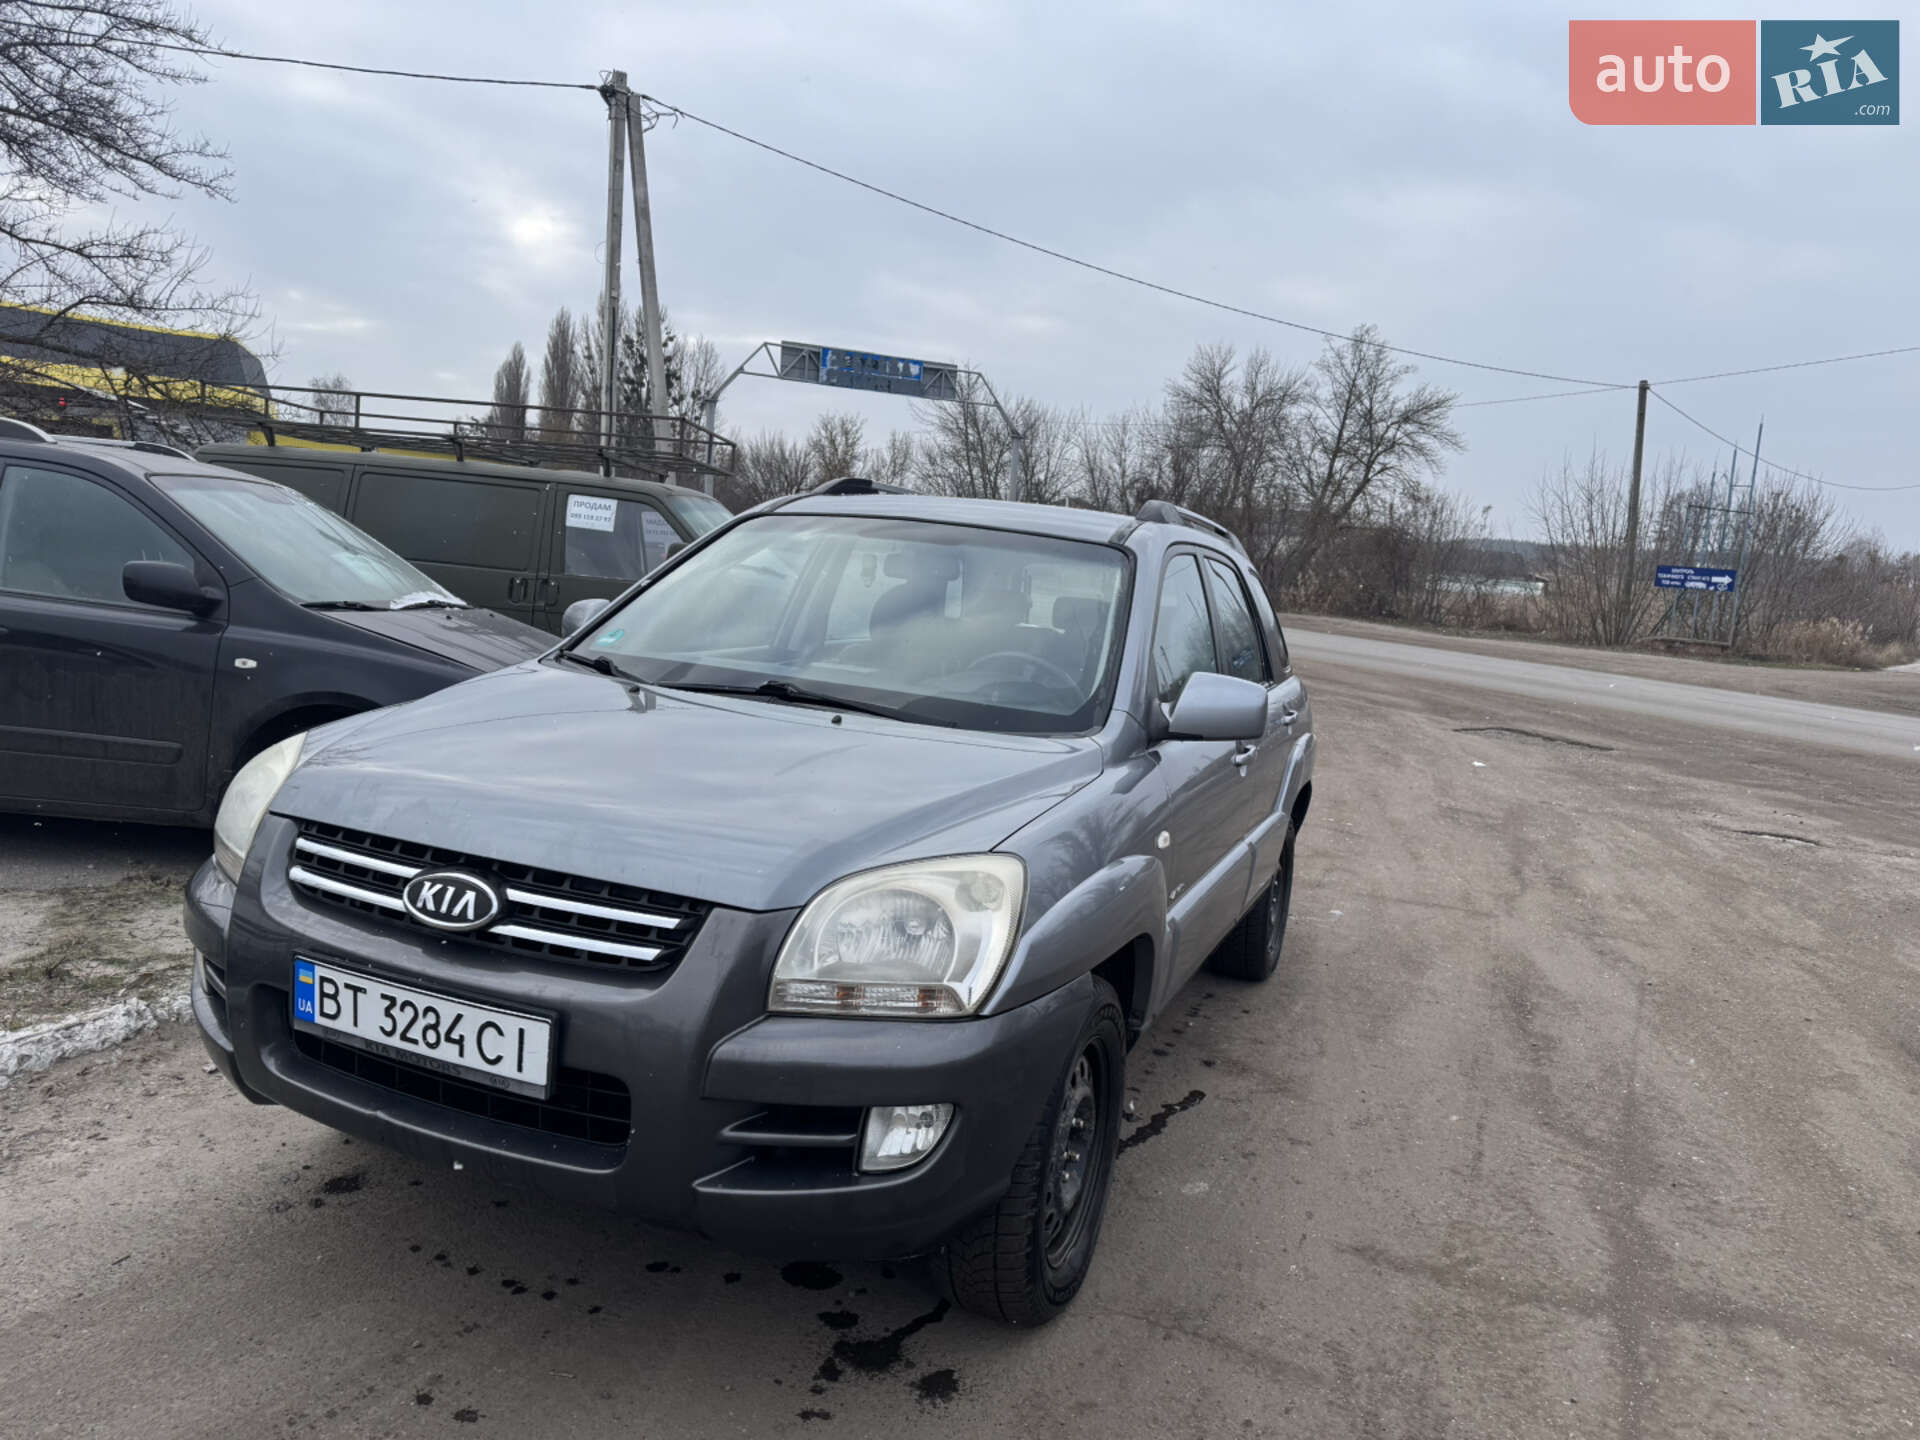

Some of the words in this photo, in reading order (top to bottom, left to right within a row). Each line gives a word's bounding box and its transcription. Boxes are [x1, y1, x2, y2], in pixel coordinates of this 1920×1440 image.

[573, 500, 612, 511] ПРОДАМ
[416, 881, 476, 920] KIA
[298, 998, 313, 1015] UA
[318, 974, 367, 1028] BT
[378, 992, 465, 1058] 3284
